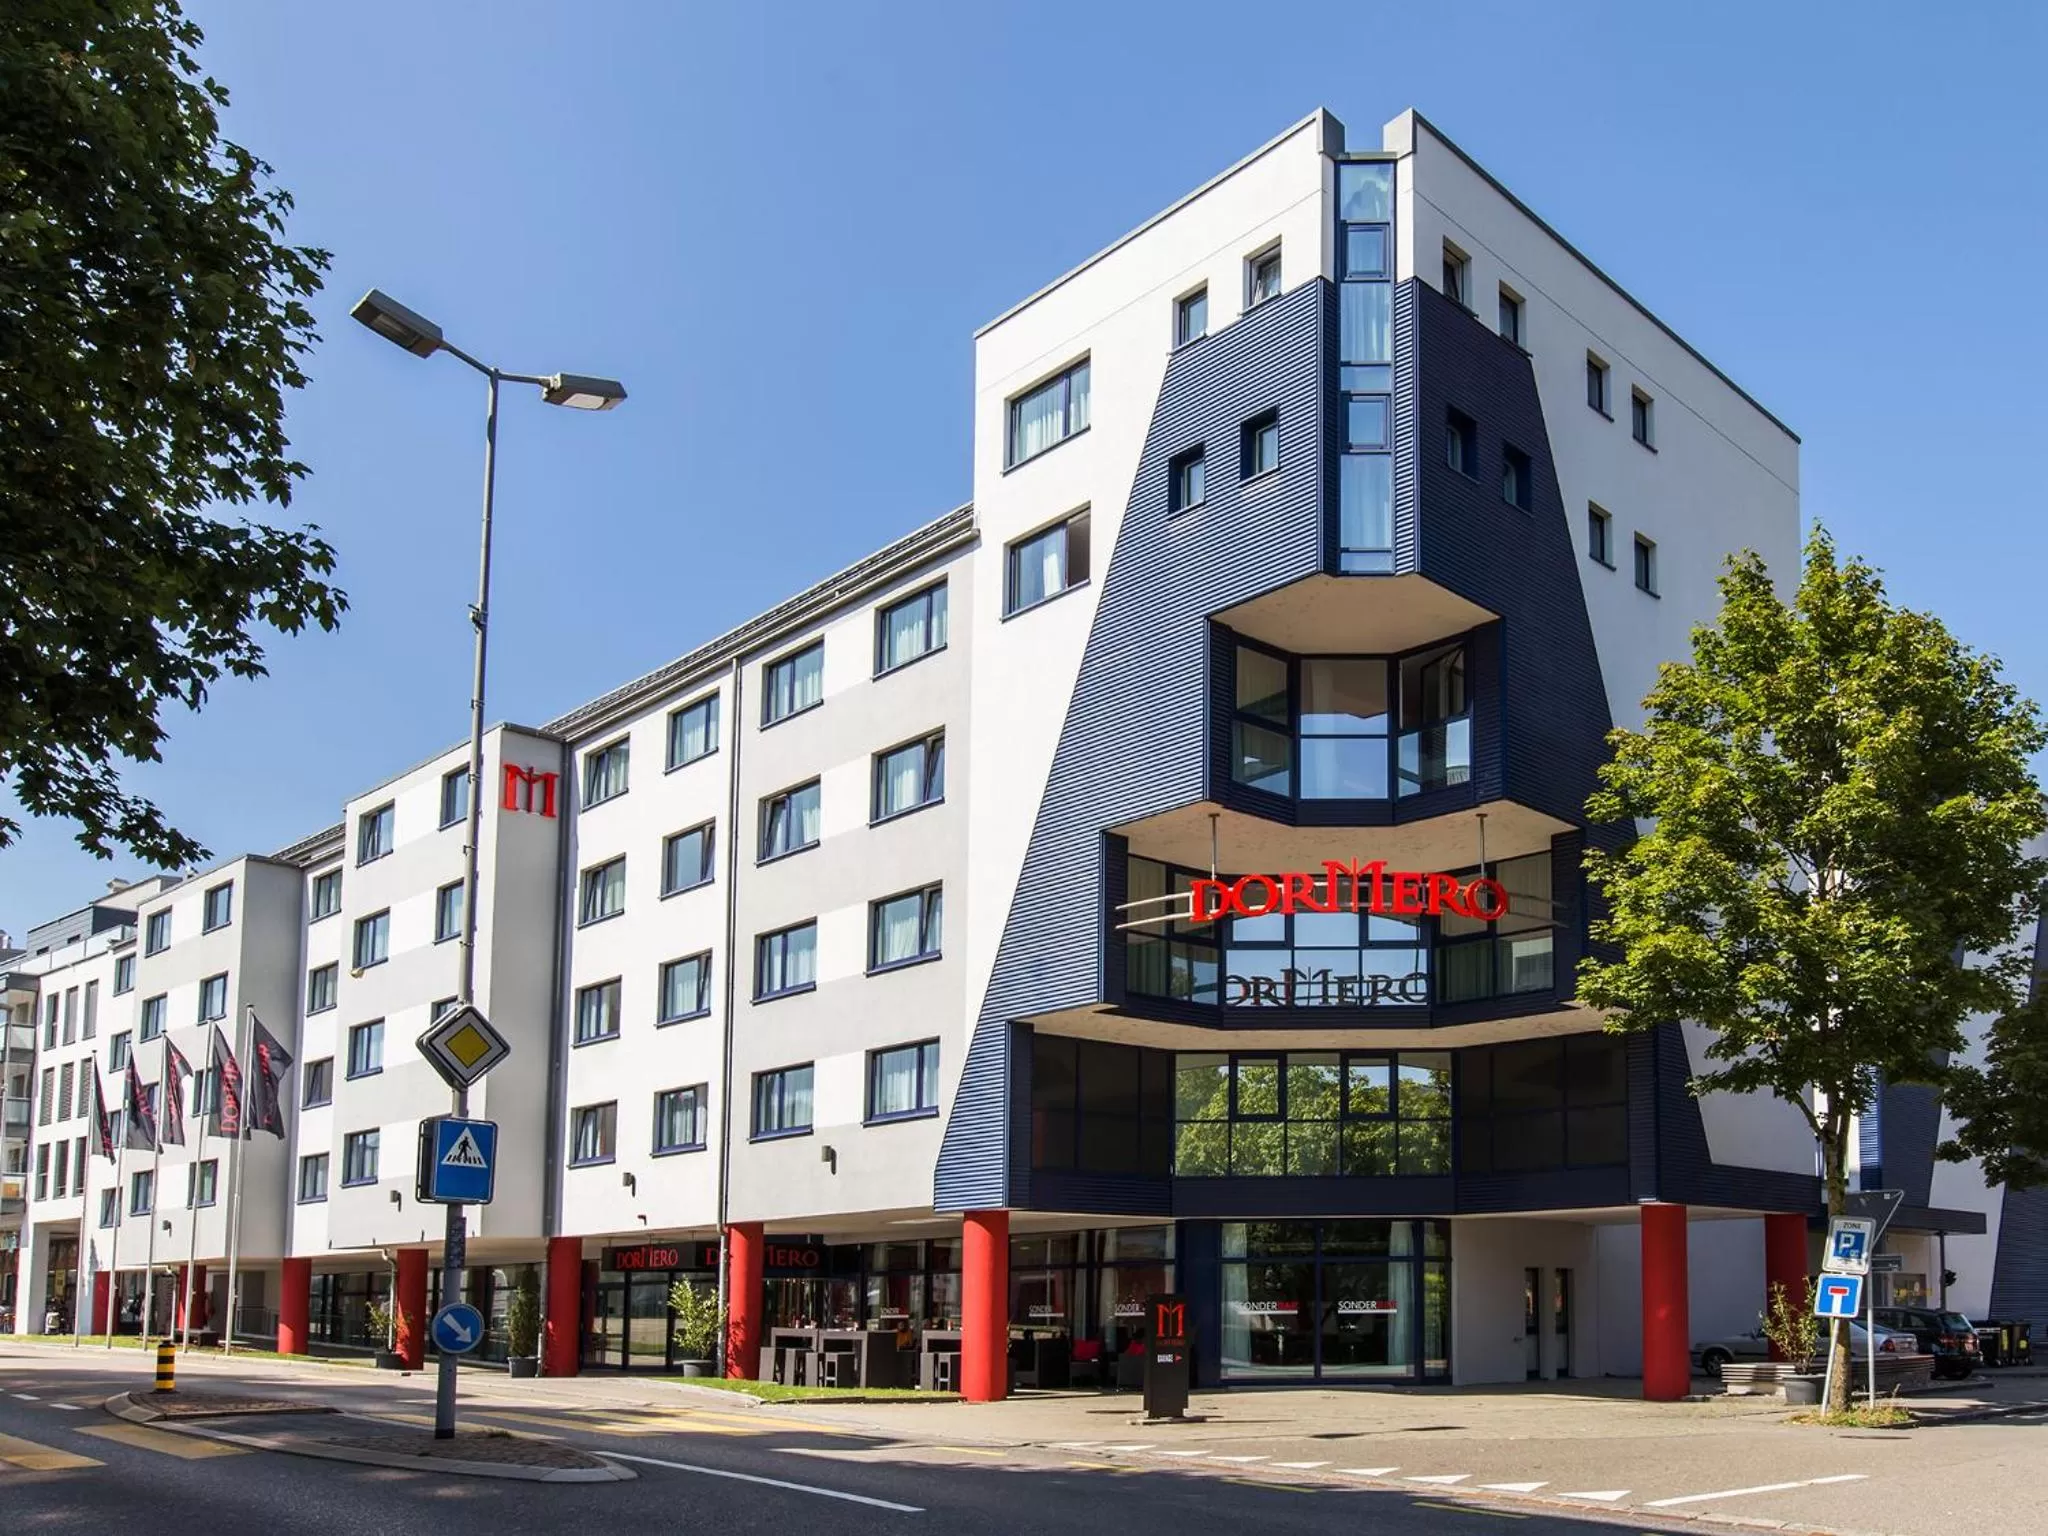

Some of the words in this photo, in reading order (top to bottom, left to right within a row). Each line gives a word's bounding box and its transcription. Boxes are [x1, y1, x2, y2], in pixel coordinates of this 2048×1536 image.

[1189, 857, 1508, 921] DORMERO
[1839, 1233, 1854, 1254] P
[616, 1246, 679, 1269] DORMERO
[705, 1246, 819, 1267] DERO
